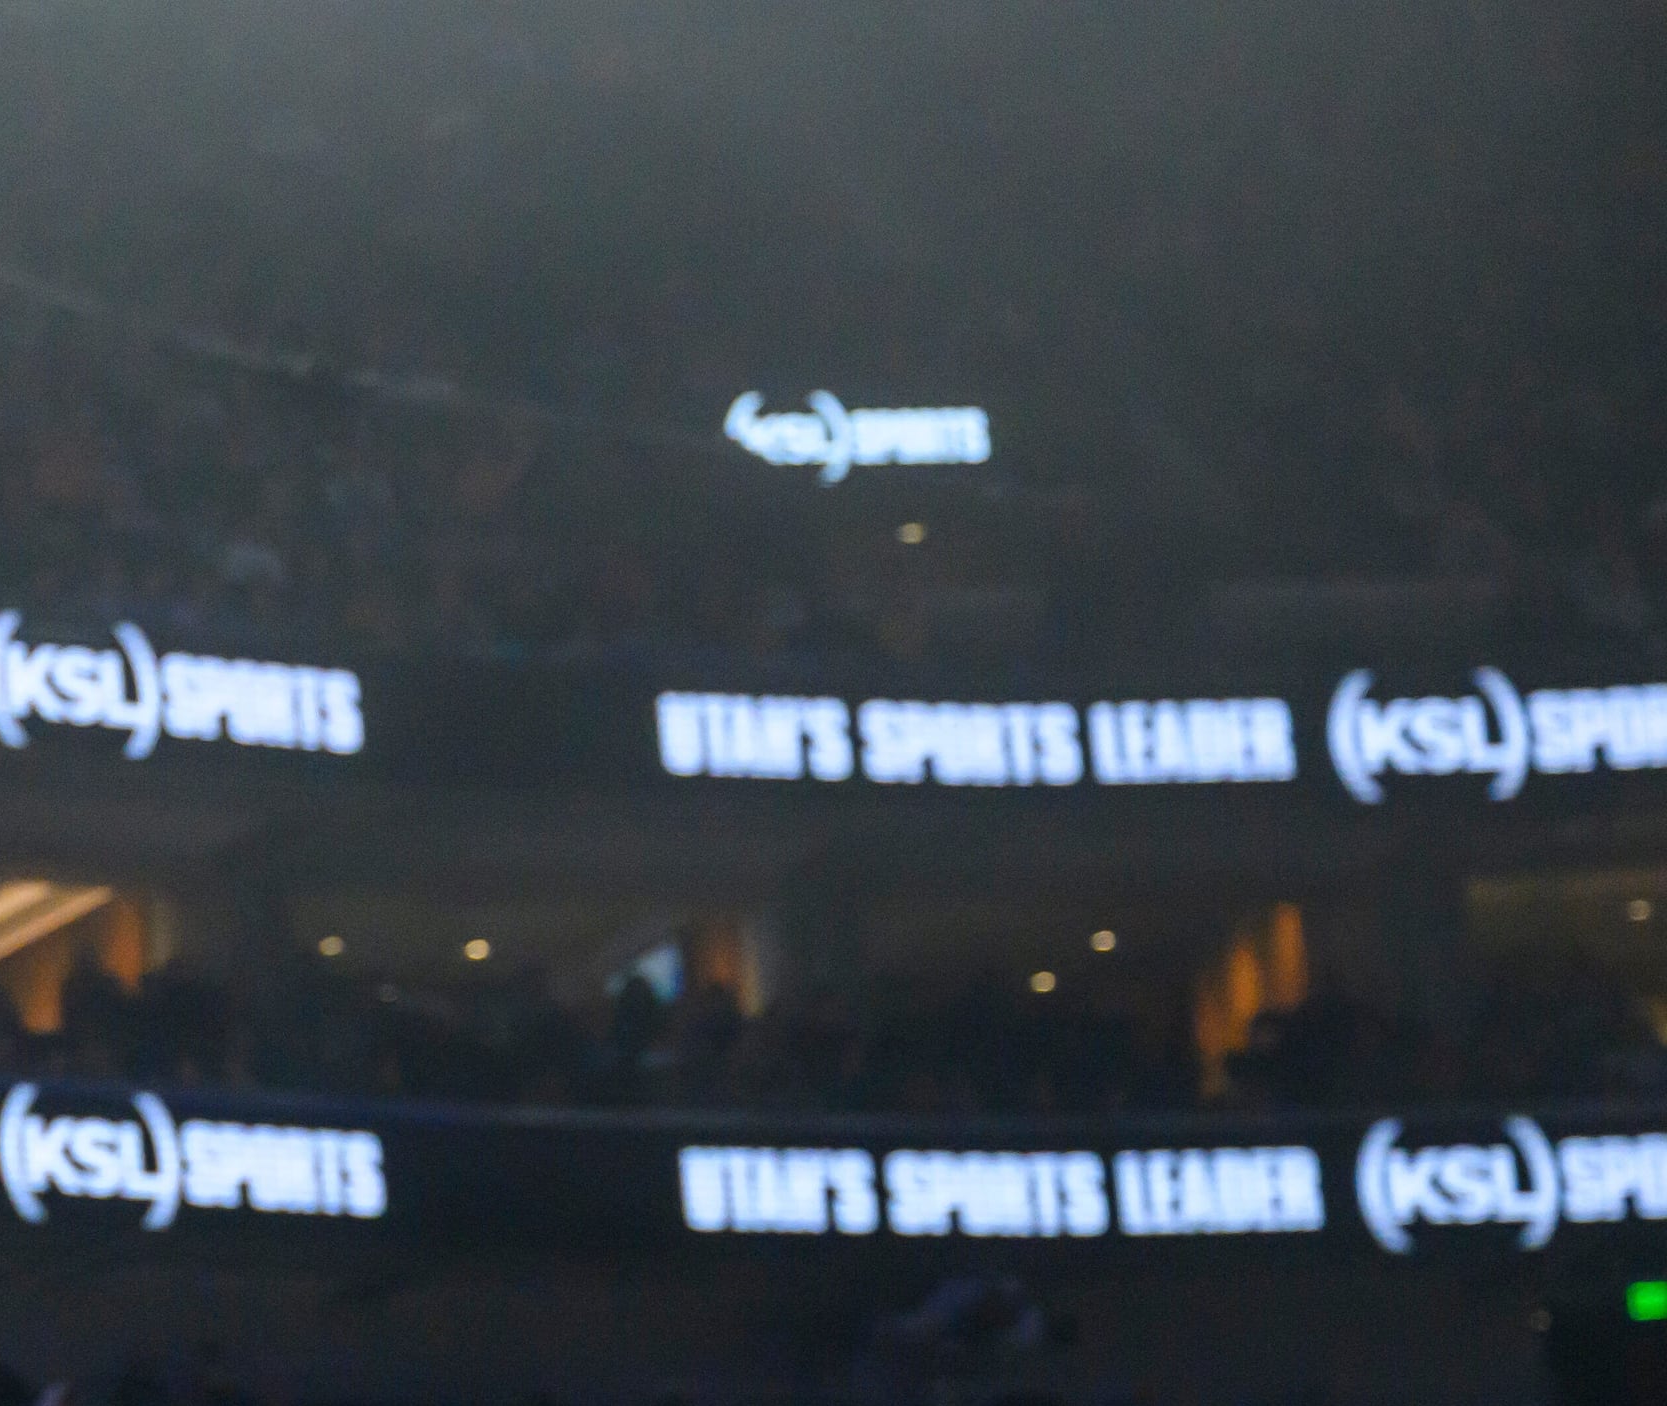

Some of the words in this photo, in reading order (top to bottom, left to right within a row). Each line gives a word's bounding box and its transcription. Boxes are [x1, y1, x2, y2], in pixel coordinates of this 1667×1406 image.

[851, 406, 991, 465] SPORTS
[158, 652, 365, 755] SPORTS
[657, 692, 852, 781] UTAH'S
[859, 699, 1083, 786] SPORTS
[1088, 698, 1297, 785] LEADER
[179, 1120, 385, 1217] SPORTS
[679, 1147, 878, 1234] UTAH'S
[885, 1151, 1108, 1237] SPORTS
[1115, 1147, 1324, 1235] LEADER
